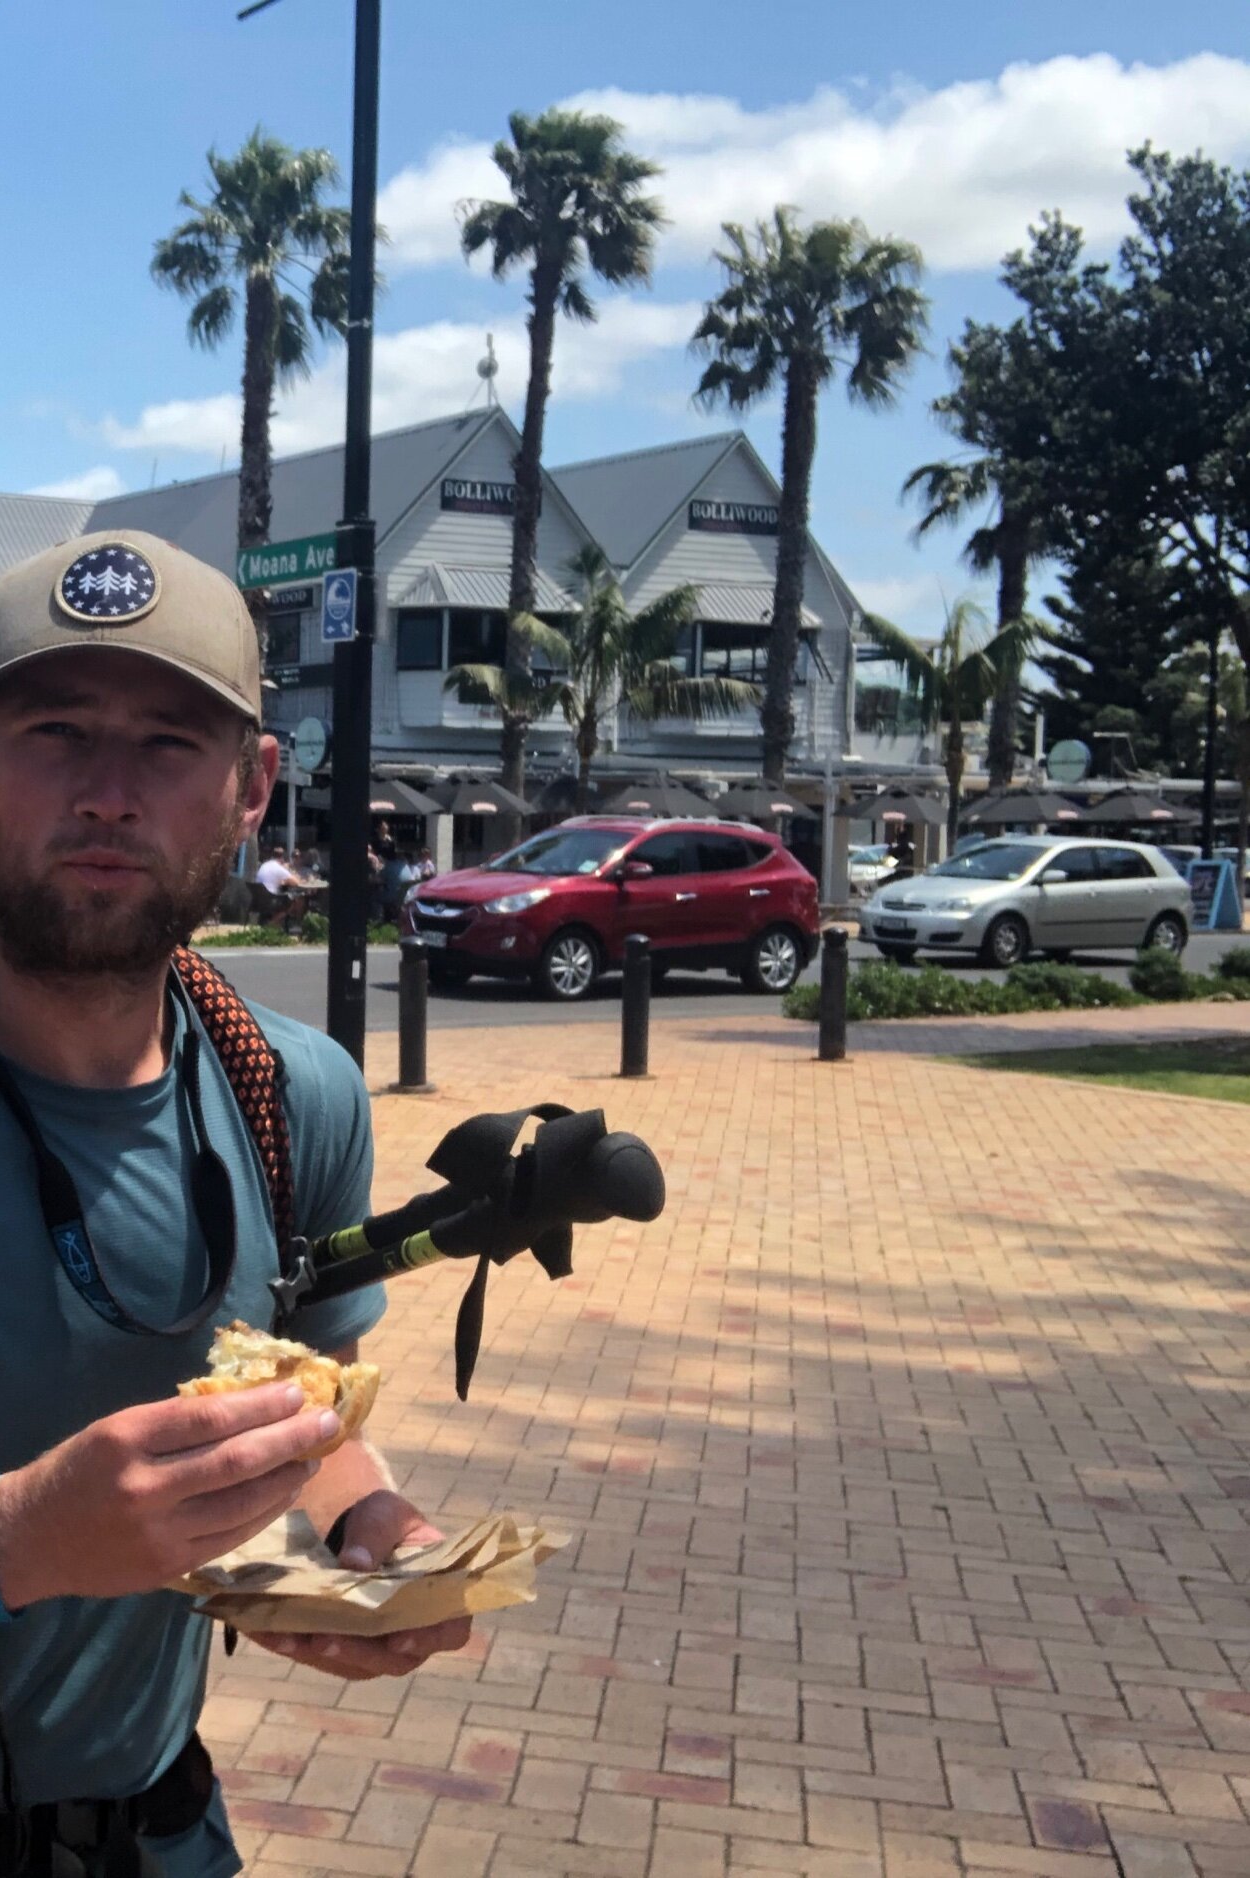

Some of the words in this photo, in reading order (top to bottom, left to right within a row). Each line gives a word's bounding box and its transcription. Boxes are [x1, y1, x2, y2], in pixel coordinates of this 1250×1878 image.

[445, 481, 515, 503] BOLLIWO
[249, 553, 298, 580] Moana
[305, 544, 335, 570] Ave
